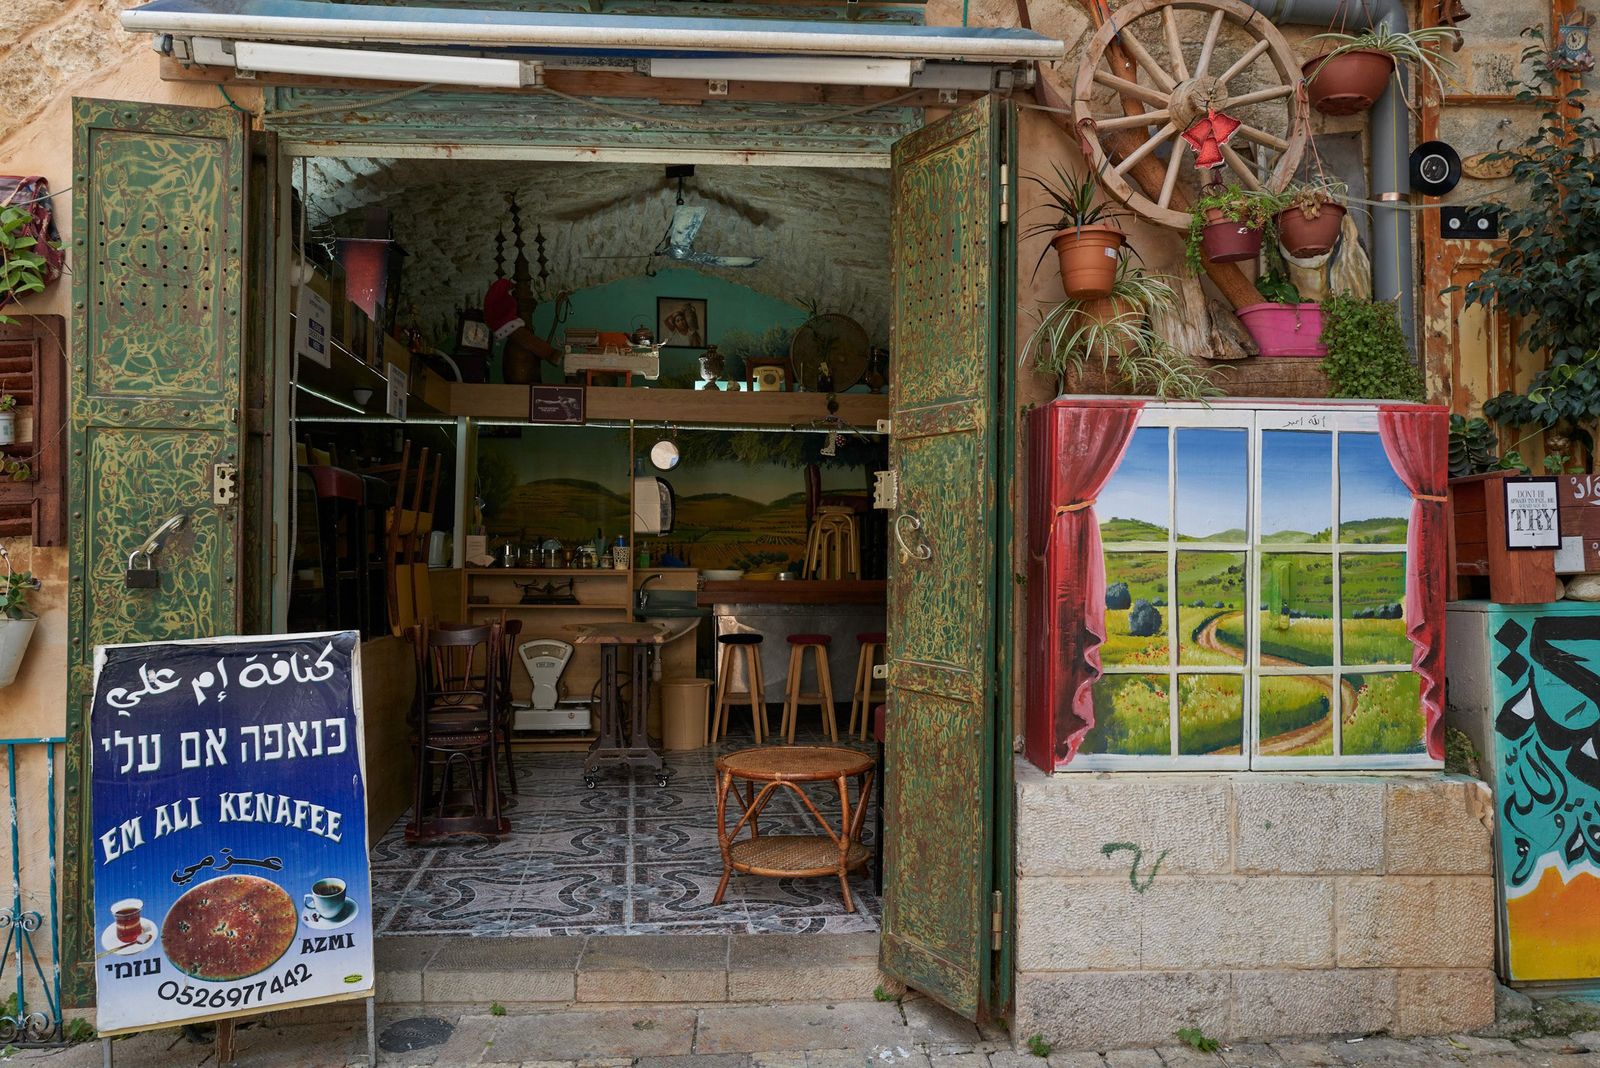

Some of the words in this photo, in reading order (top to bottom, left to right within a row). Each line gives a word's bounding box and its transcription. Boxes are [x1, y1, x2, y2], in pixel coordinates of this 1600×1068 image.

[1510, 508, 1557, 532] TRY
[239, 641, 335, 688] كنافة
[106, 663, 182, 717] علي
[101, 730, 162, 775] עלי
[180, 727, 228, 770] אם
[99, 815, 146, 866] EM
[154, 796, 203, 840] ALI
[218, 791, 344, 844] KENAFEE
[171, 848, 284, 886] عزمي
[301, 933, 356, 955] AZMI
[105, 956, 162, 979] עזמי
[157, 963, 313, 1008] 0526977442
